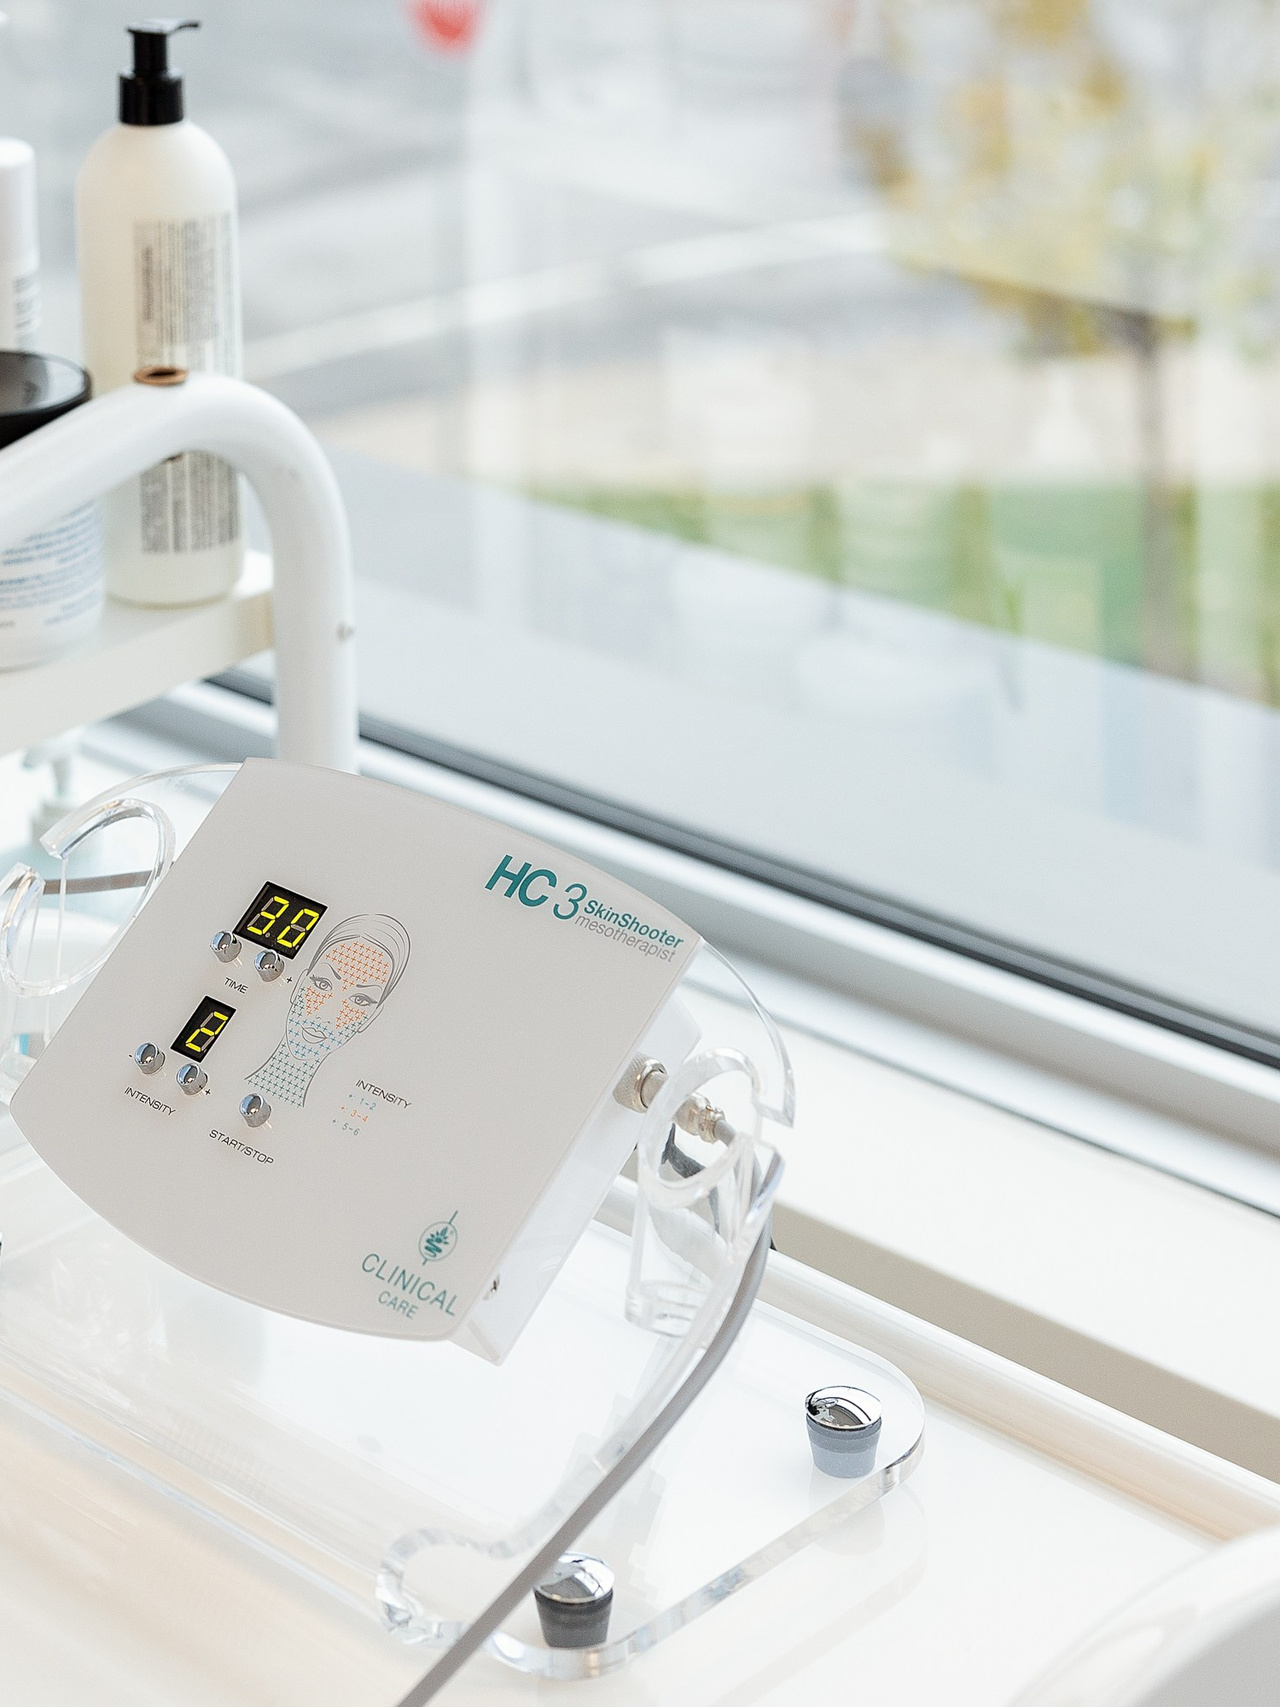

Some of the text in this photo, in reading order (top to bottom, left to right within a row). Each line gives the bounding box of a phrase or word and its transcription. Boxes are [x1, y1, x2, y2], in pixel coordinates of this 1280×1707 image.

[484, 854, 588, 920] HC 3
[245, 895, 320, 948] 30
[574, 913, 677, 963] mesotherapist
[583, 899, 684, 949] SkinShooter
[223, 976, 249, 995] TIME
[185, 1010, 229, 1053] 2
[124, 1085, 176, 1117] INTENSITY
[355, 1078, 412, 1110] INTENSITY
[208, 1128, 275, 1166] START/STOP
[361, 1252, 459, 1317] CLINICAL
[377, 1289, 420, 1320] CARE
